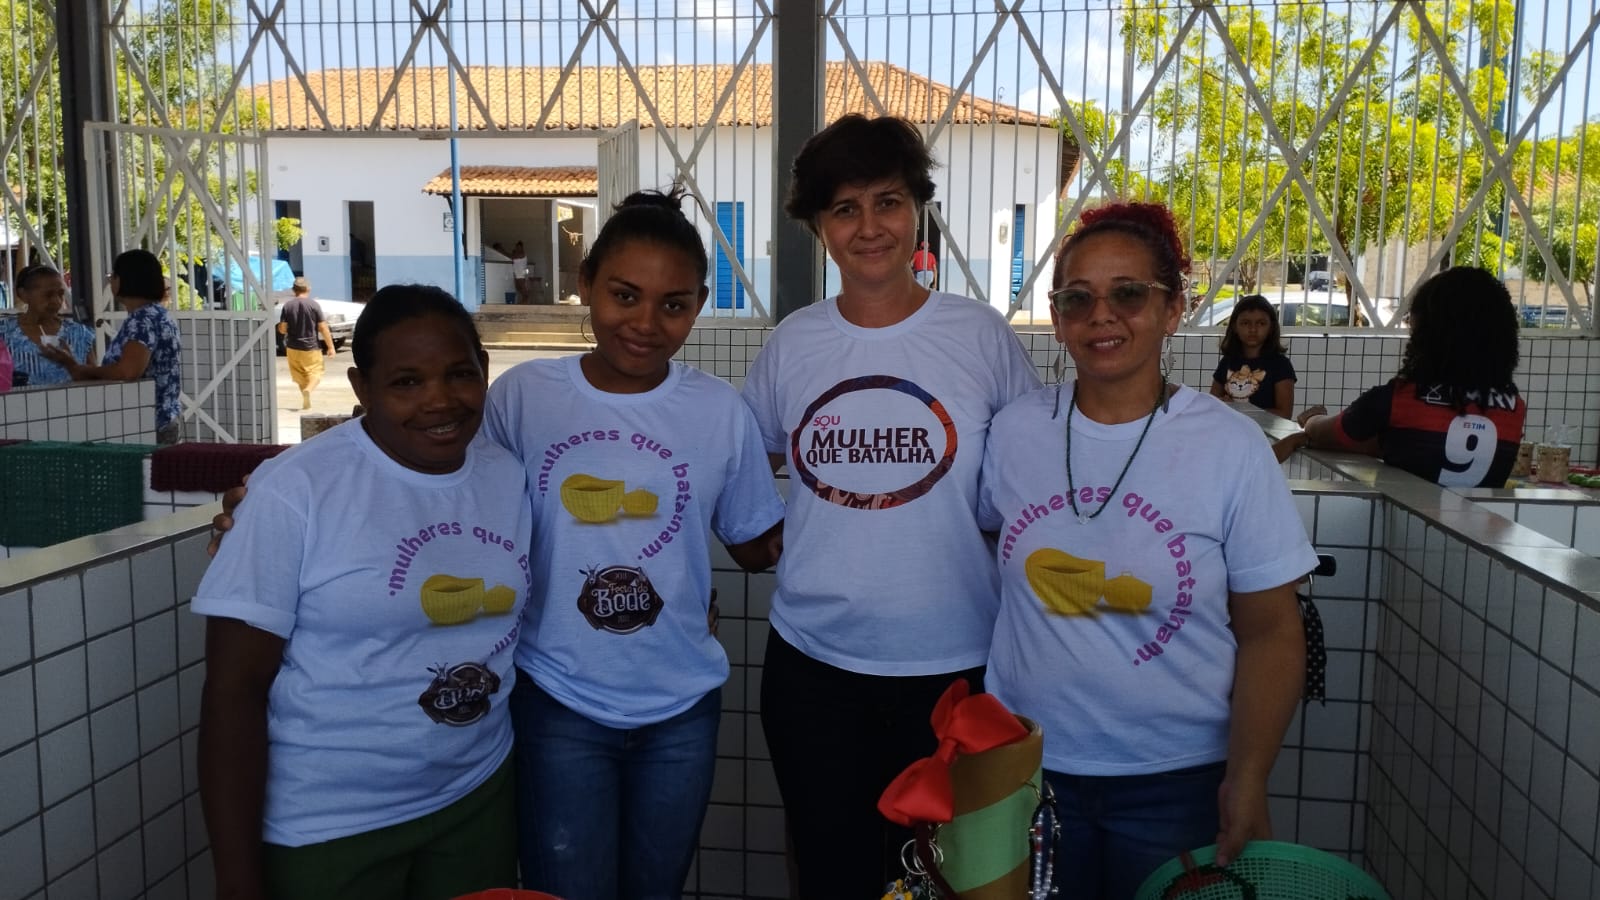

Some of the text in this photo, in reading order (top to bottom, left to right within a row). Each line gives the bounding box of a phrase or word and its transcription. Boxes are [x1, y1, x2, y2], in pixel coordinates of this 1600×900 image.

[813, 415, 841, 430] SOU
[630, 432, 673, 460] que
[811, 427, 930, 450] MULHER
[1438, 414, 1498, 488] 9
[806, 447, 936, 467] QUE BATALHA
[1122, 492, 1174, 533] que
[472, 526, 515, 552] que
[591, 587, 651, 617] Bode
